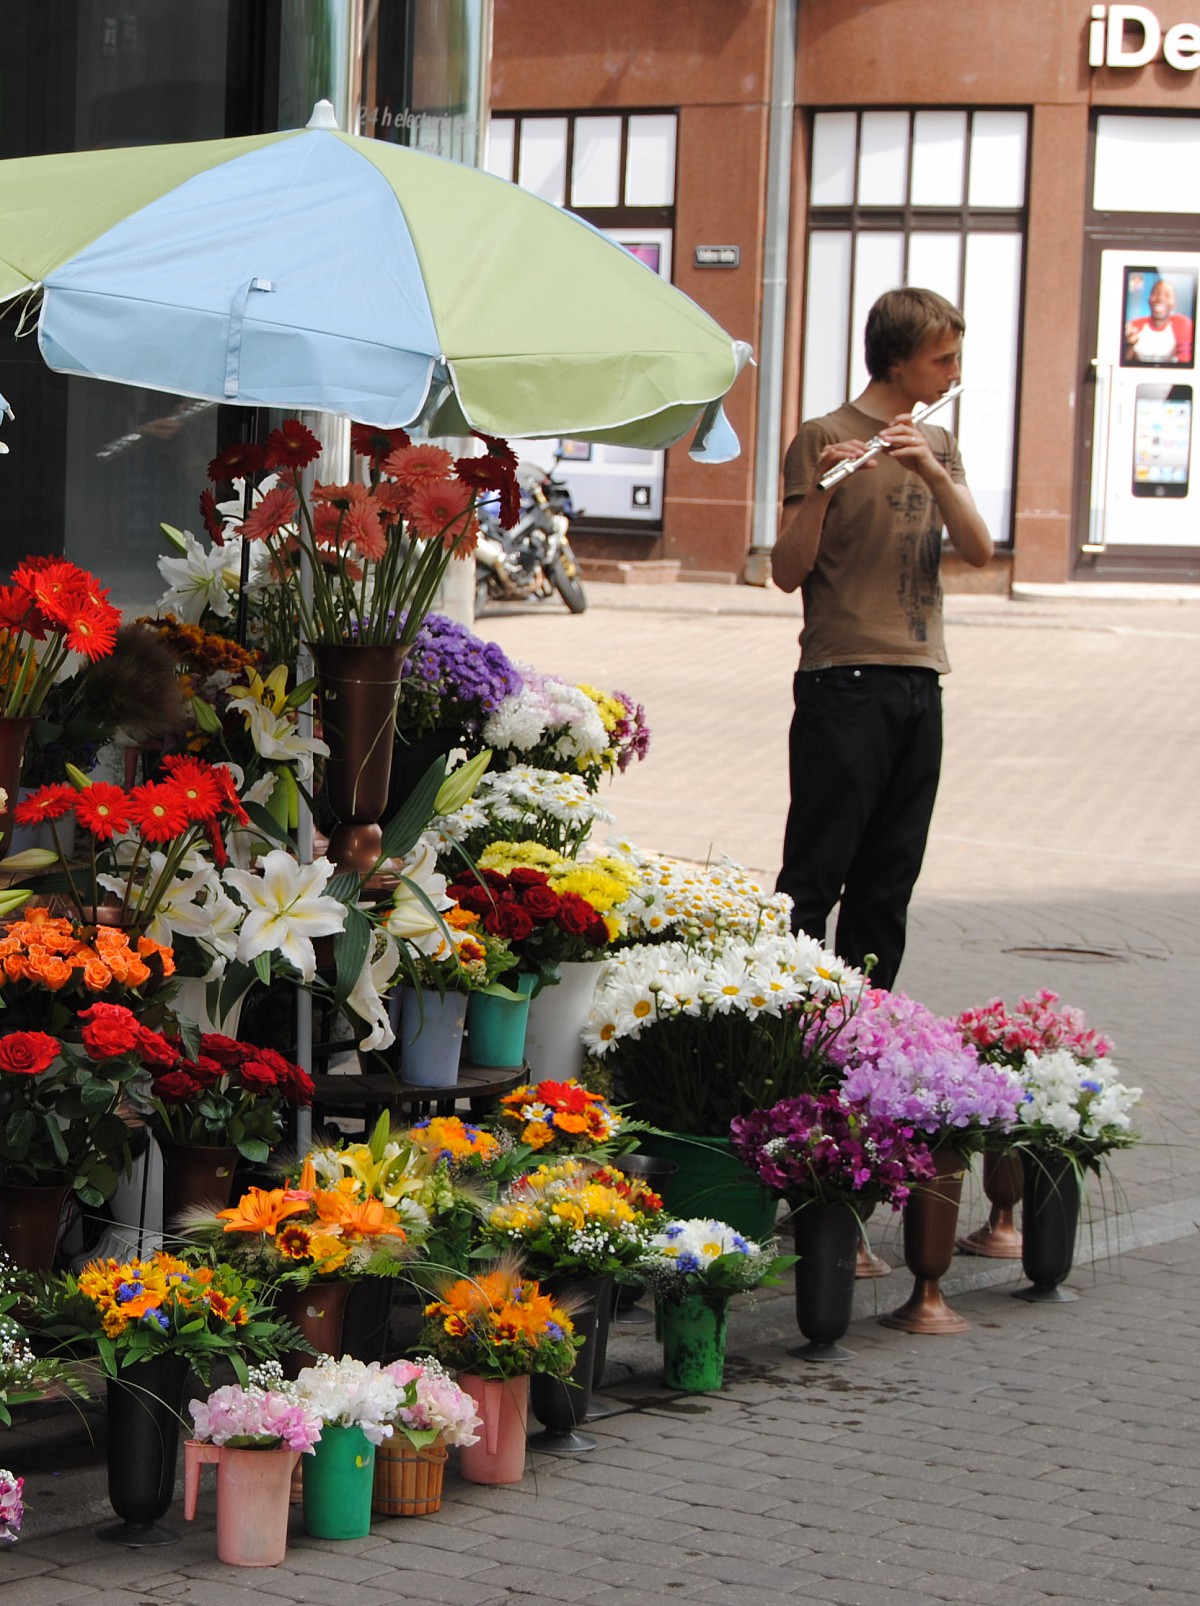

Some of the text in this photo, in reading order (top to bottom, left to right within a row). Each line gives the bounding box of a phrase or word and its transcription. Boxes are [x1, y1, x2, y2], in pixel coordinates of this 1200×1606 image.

[1089, 4, 1200, 71] iDe
[360, 106, 379, 126] 24
[381, 106, 392, 127] h
